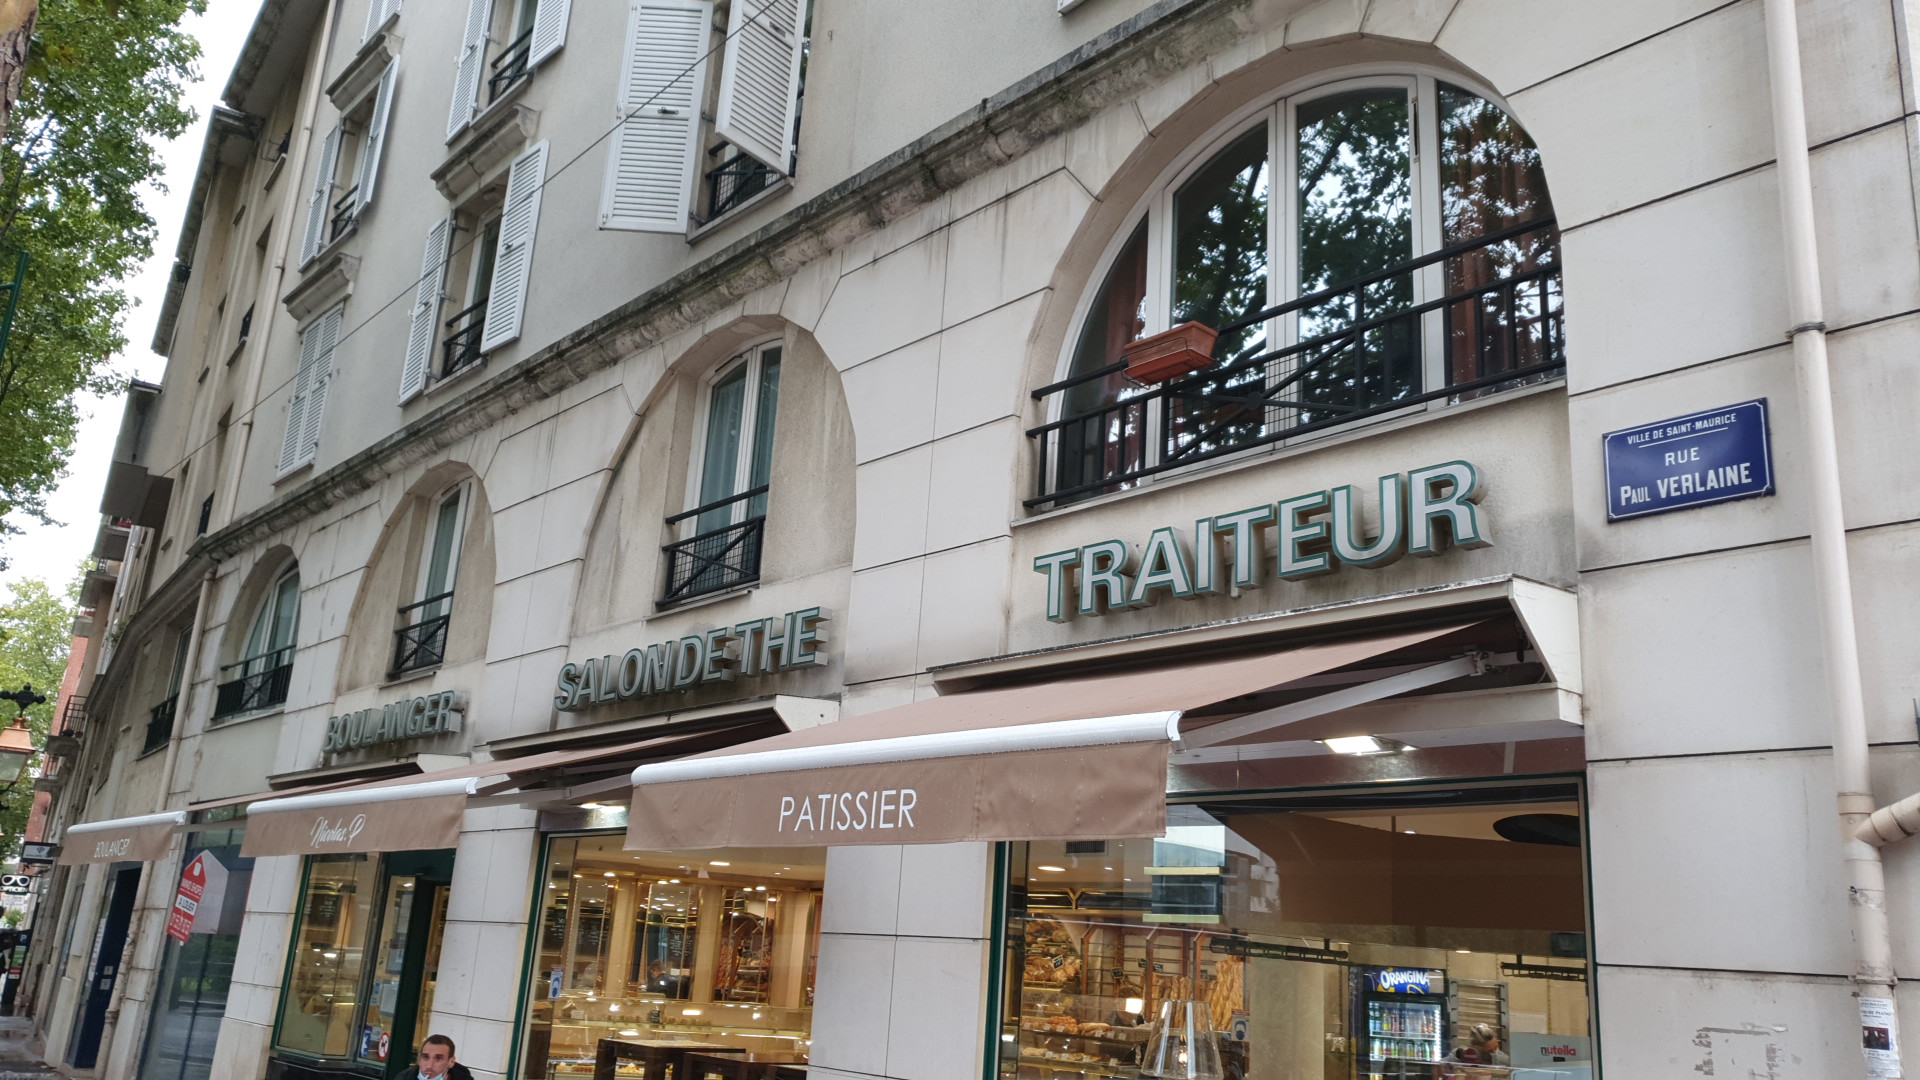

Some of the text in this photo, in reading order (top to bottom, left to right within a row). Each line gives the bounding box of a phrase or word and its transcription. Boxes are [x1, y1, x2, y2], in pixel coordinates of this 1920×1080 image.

[1627, 413, 1737, 445] VILLE DE SAINT-MAURICE
[1664, 447, 1700, 467] RUE
[1656, 463, 1753, 499] VERLAINE
[1033, 459, 1489, 623] TRAITEUR
[555, 606, 831, 713] SALON DE THE
[323, 690, 463, 754] BOULANGER
[778, 788, 918, 833] PATISSIER
[1380, 970, 1431, 990] ORANGINA
[1540, 1045, 1577, 1057] nutella
